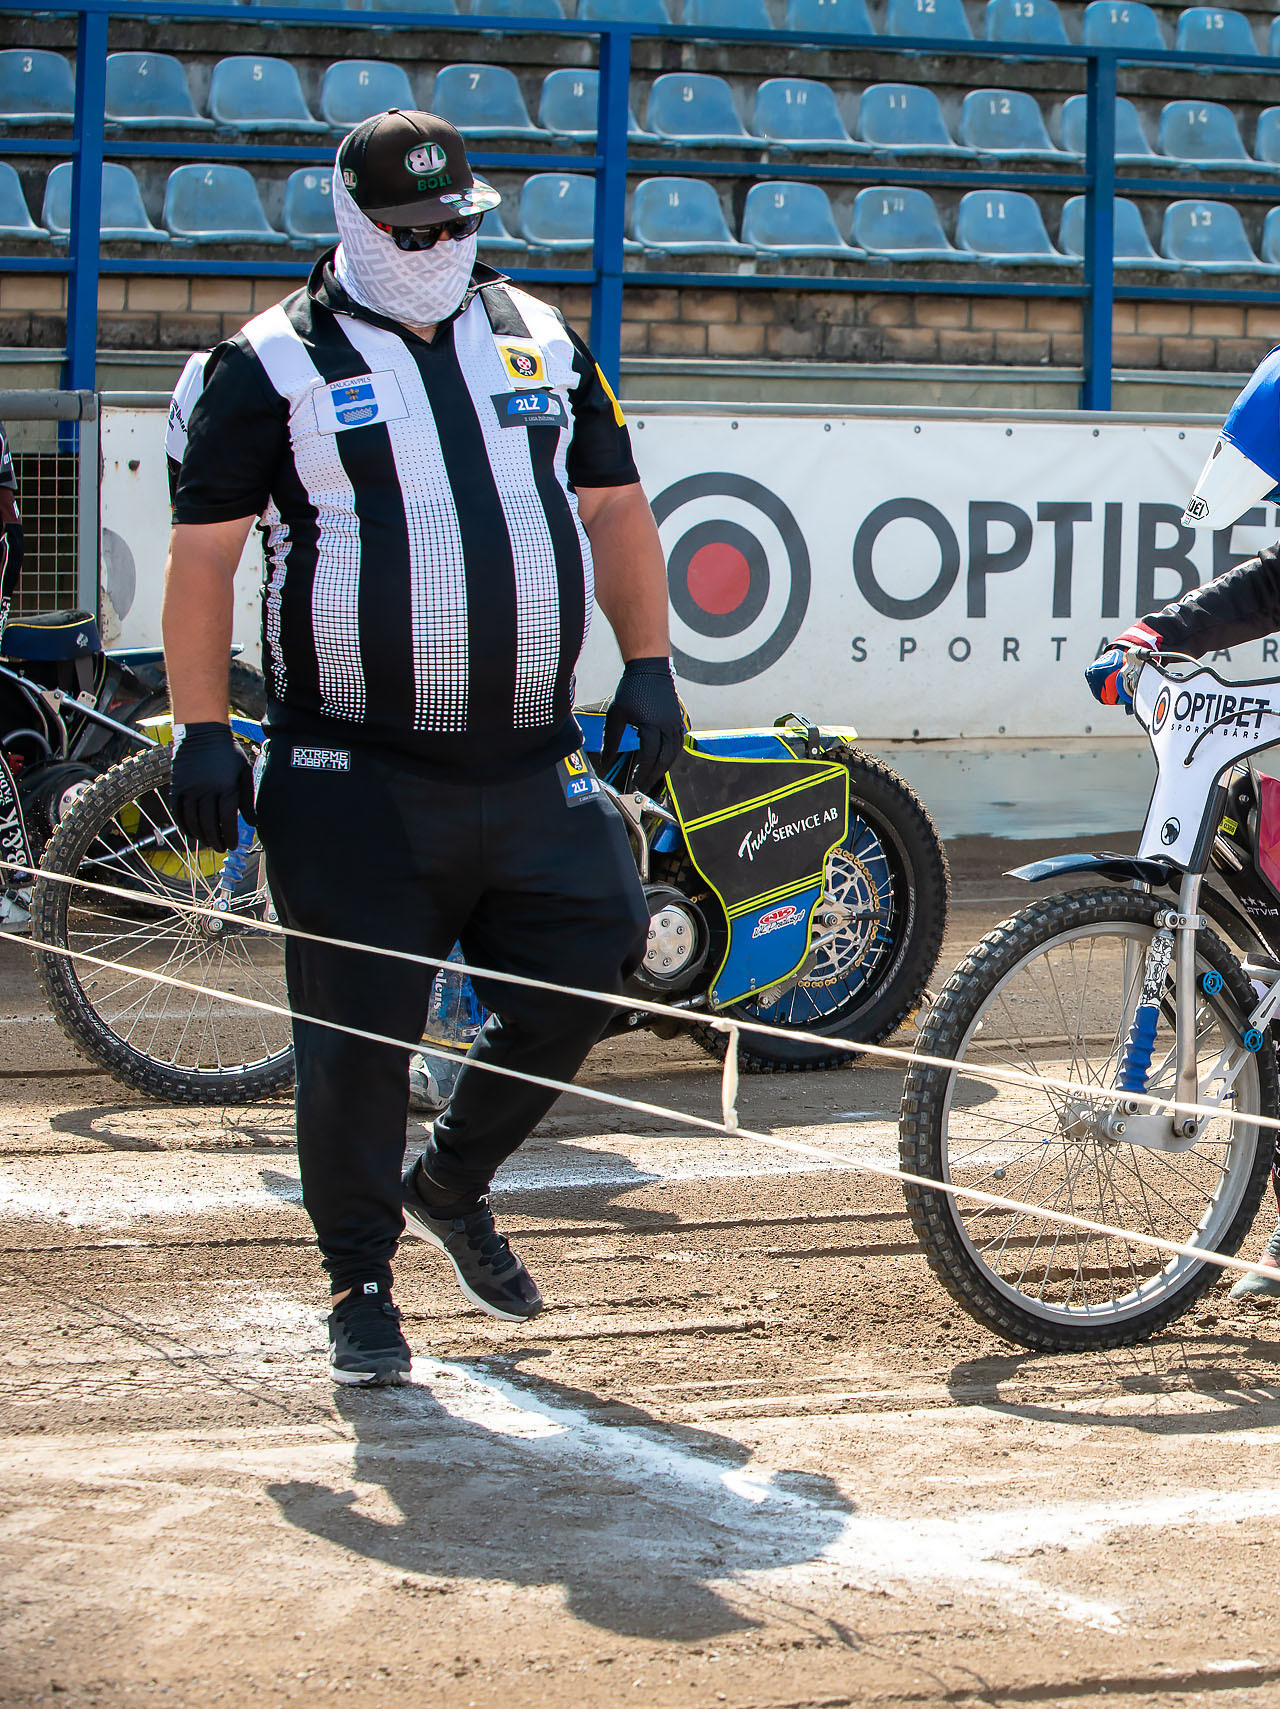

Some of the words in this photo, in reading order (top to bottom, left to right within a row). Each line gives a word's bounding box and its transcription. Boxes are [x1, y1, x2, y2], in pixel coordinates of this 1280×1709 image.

[1015, 3, 1034, 17] 13
[1110, 9, 1130, 23] 14
[1206, 15, 1225, 29] 15
[23, 56, 33, 73] 3
[252, 65, 263, 81] 5
[358, 70, 370, 87] 6
[469, 73, 481, 90] 7
[889, 95, 907, 109] 11
[989, 99, 1011, 115] 12
[1188, 107, 1208, 124] 14
[203, 170, 213, 186] 4
[417, 174, 453, 192] BOLL
[320, 178, 331, 195] 5
[559, 182, 570, 198] 7
[986, 202, 1005, 219] 11
[1190, 211, 1212, 227] 13
[329, 377, 371, 390] DAUGAVPILS
[851, 637, 1106, 663] SPORT
[1174, 691, 1270, 729] OPTIBET
[293, 749, 348, 761] EXTREME
[293, 757, 328, 768] HOBBY
[772, 814, 821, 842] SERVICE
[823, 807, 839, 823] AB
[738, 806, 779, 861] Truck
[1247, 908, 1279, 917] ATVIA
